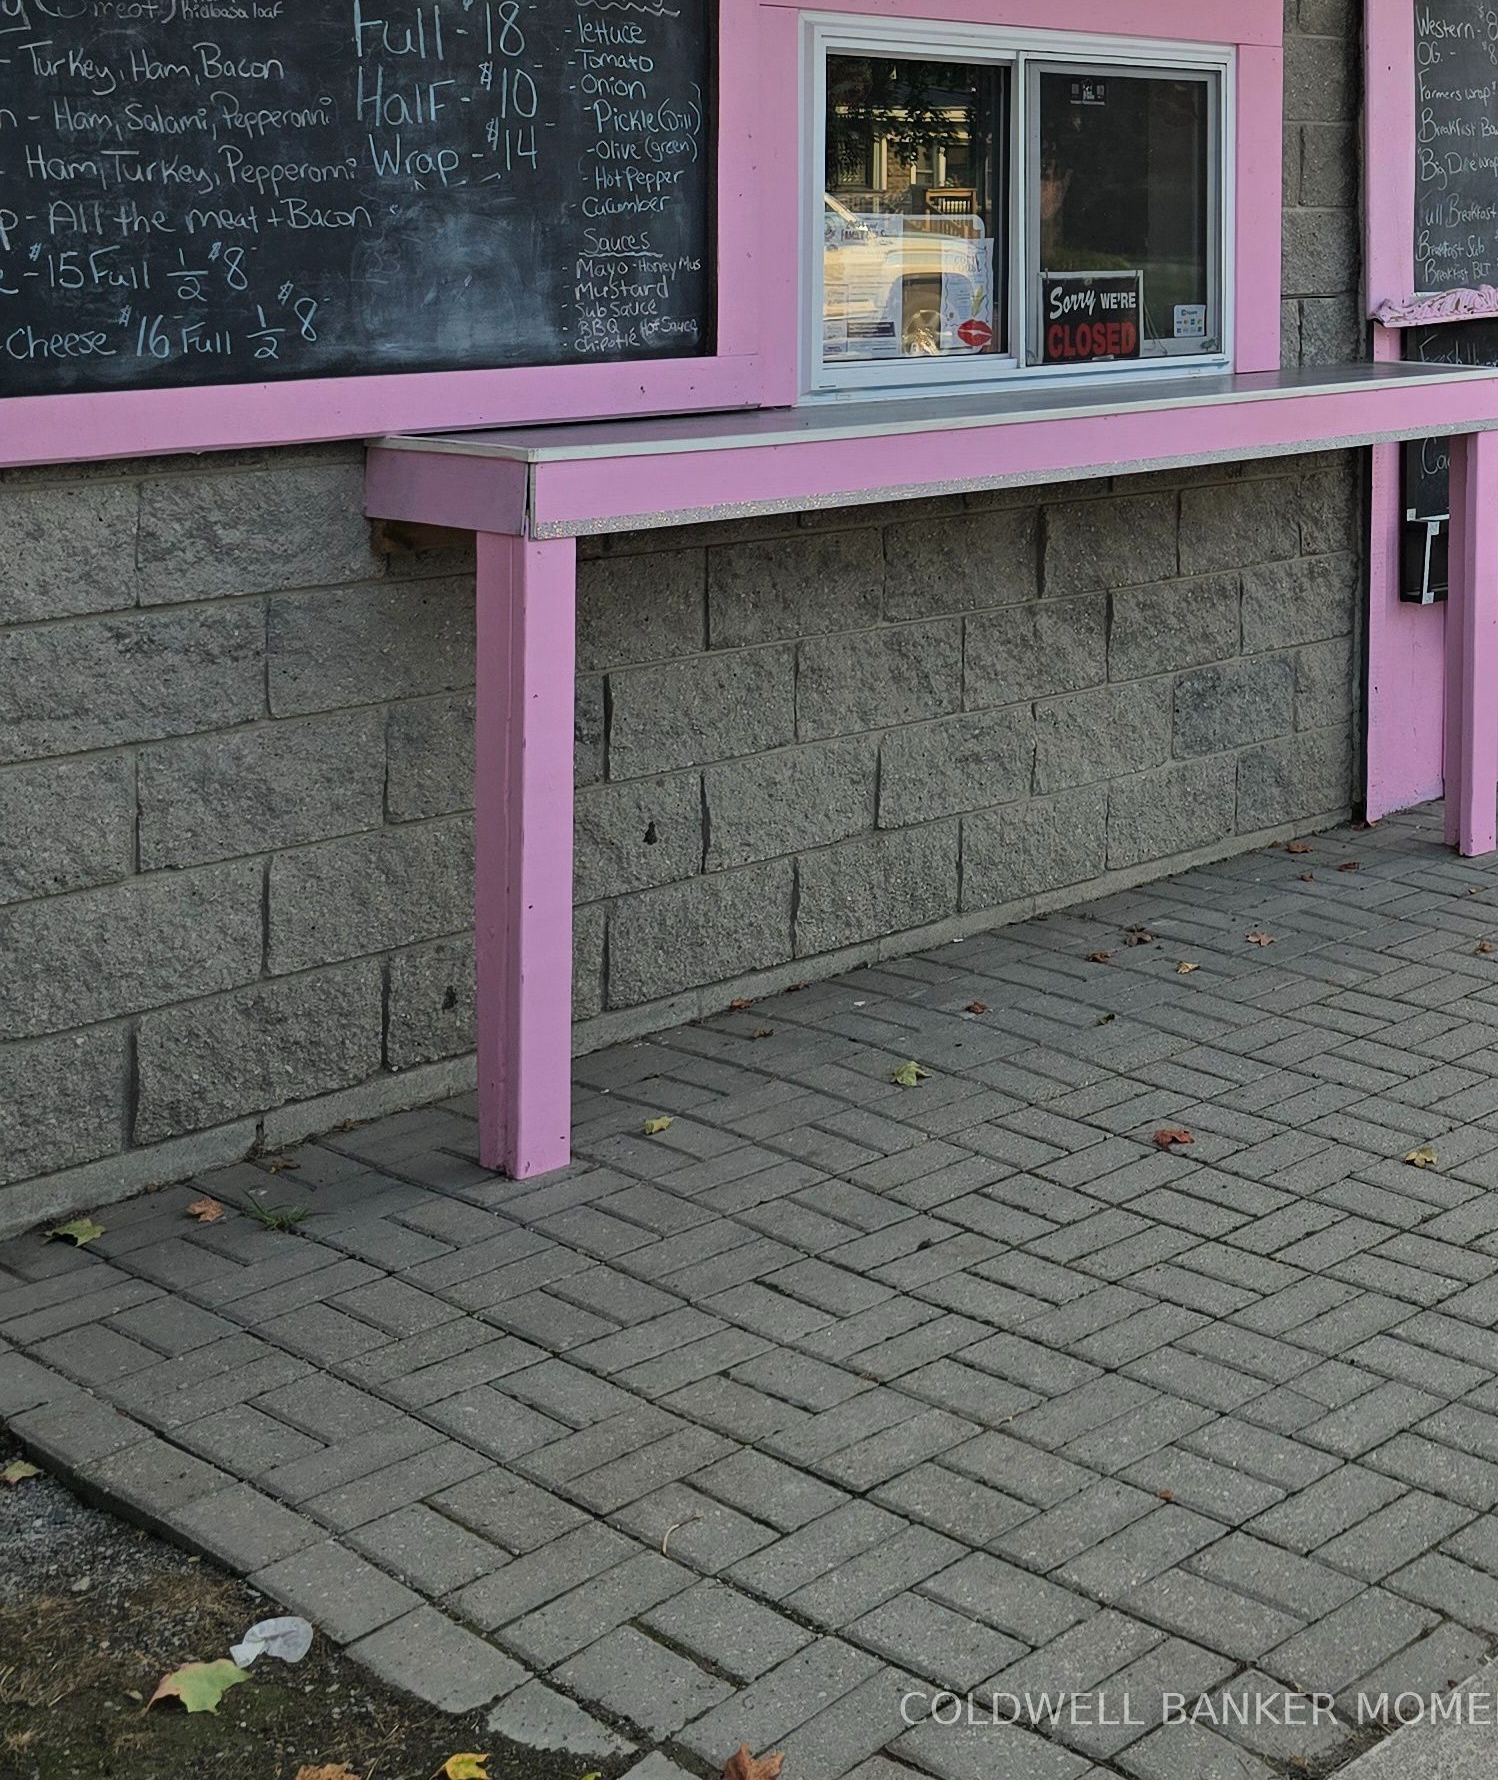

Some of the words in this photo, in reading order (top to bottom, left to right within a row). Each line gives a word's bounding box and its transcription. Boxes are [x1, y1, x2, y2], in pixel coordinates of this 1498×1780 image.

[253, 1, 285, 20] loaf
[193, 42, 285, 80] Bacon
[574, 49, 654, 73] Tomato
[580, 73, 647, 100] Onion
[368, 133, 460, 188] Wrap
[595, 139, 642, 160] Olive
[49, 200, 103, 235] All
[114, 201, 177, 236] the
[185, 206, 259, 234] meat
[280, 197, 373, 229] Bacon
[583, 228, 651, 255] Sauces
[89, 245, 151, 289] Full
[576, 258, 629, 283] Mayo
[1472, 261, 1492, 281] BLT
[574, 275, 669, 301] Mustard
[1049, 286, 1097, 320] Sorry
[1100, 291, 1137, 310] WE'RE
[6, 325, 117, 360] Cheese
[181, 322, 232, 355] Full
[577, 319, 620, 339] BBQ
[1047, 321, 1137, 358] CLOSED
